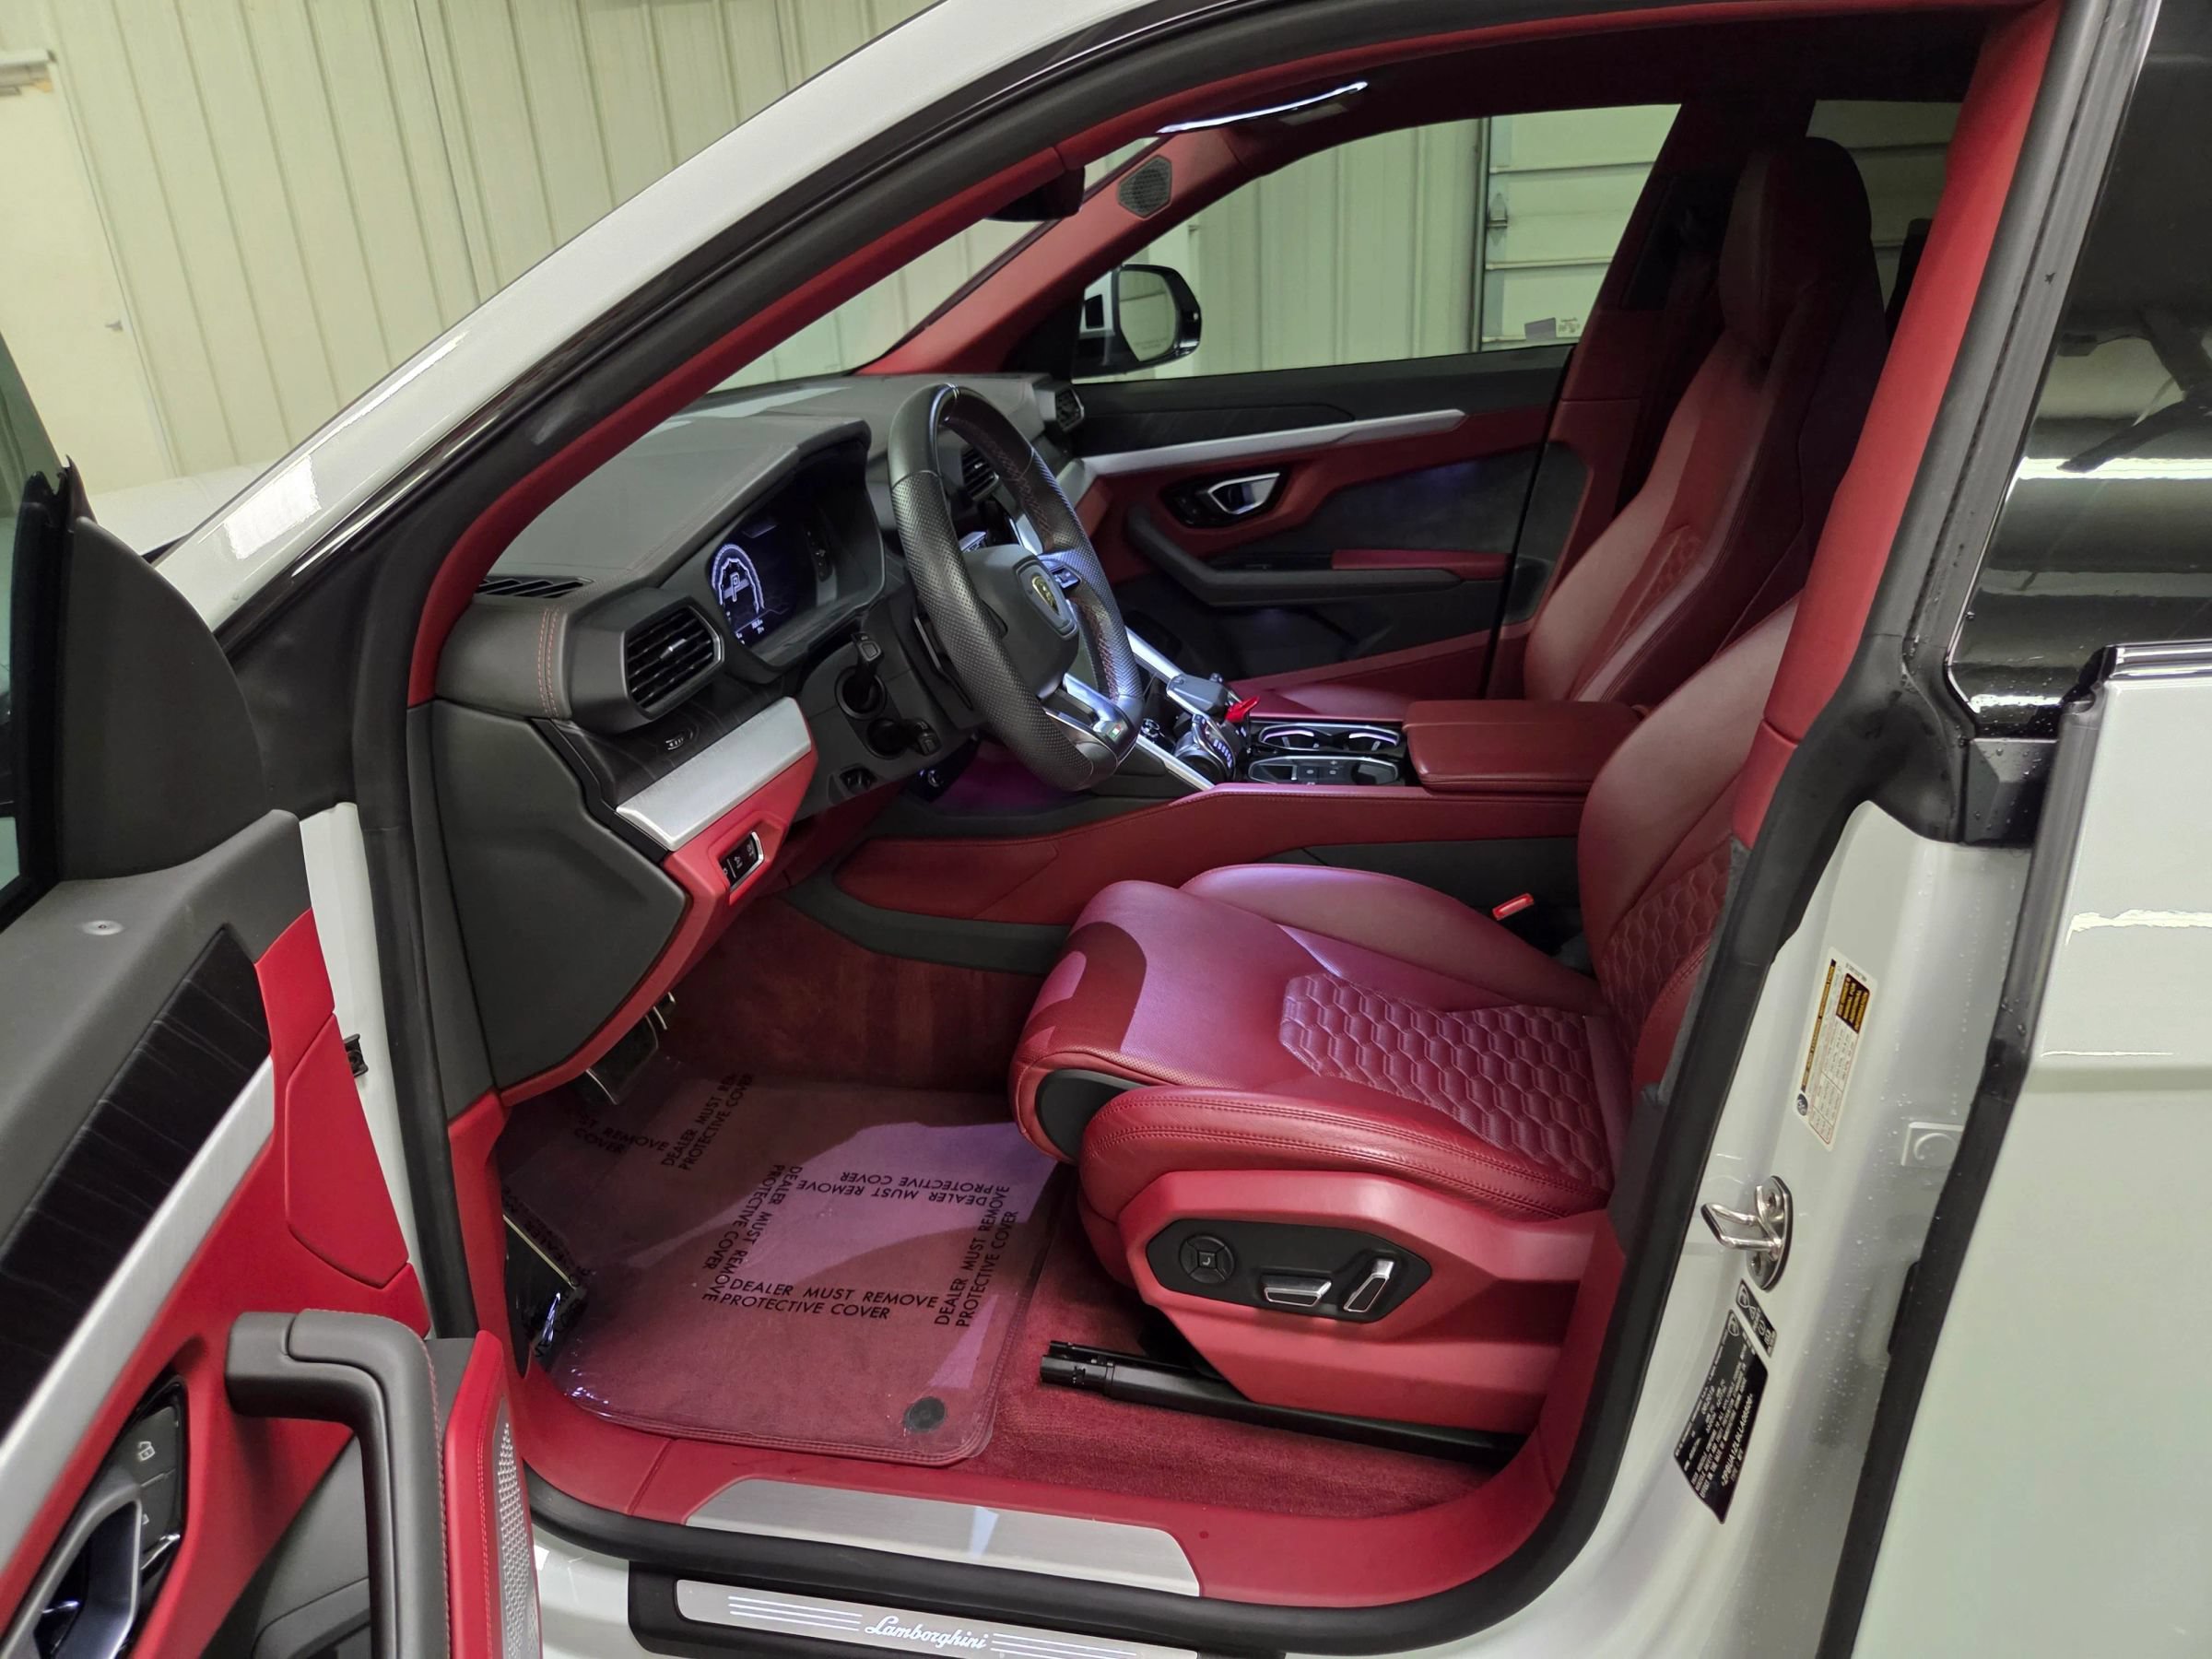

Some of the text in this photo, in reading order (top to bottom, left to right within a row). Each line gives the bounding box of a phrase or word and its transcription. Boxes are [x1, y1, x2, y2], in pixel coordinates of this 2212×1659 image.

[660, 1129, 697, 1166] DEALER
[694, 1095, 723, 1124] MUST
[678, 1073, 755, 1171] PROTECTIVE COVER
[573, 1127, 629, 1154] COVER
[601, 1127, 669, 1151] REMOVE
[796, 1180, 987, 1206] DEALER MUST REMOVE
[841, 1171, 994, 1194] PROTECTIVE COVER
[701, 1166, 803, 1301] DEALER MUST REMOVE
[702, 1164, 785, 1270] PROTECTIVE COVER
[934, 1185, 1010, 1326] DEALER MUST REMOVE
[955, 1210, 1019, 1327] PROTECTIVE COVER
[720, 1293, 892, 1320] PROTECTIVE COVER
[729, 1278, 940, 1309] DEALER MUST REMOVE
[865, 1616, 989, 1649] Lamborghini
